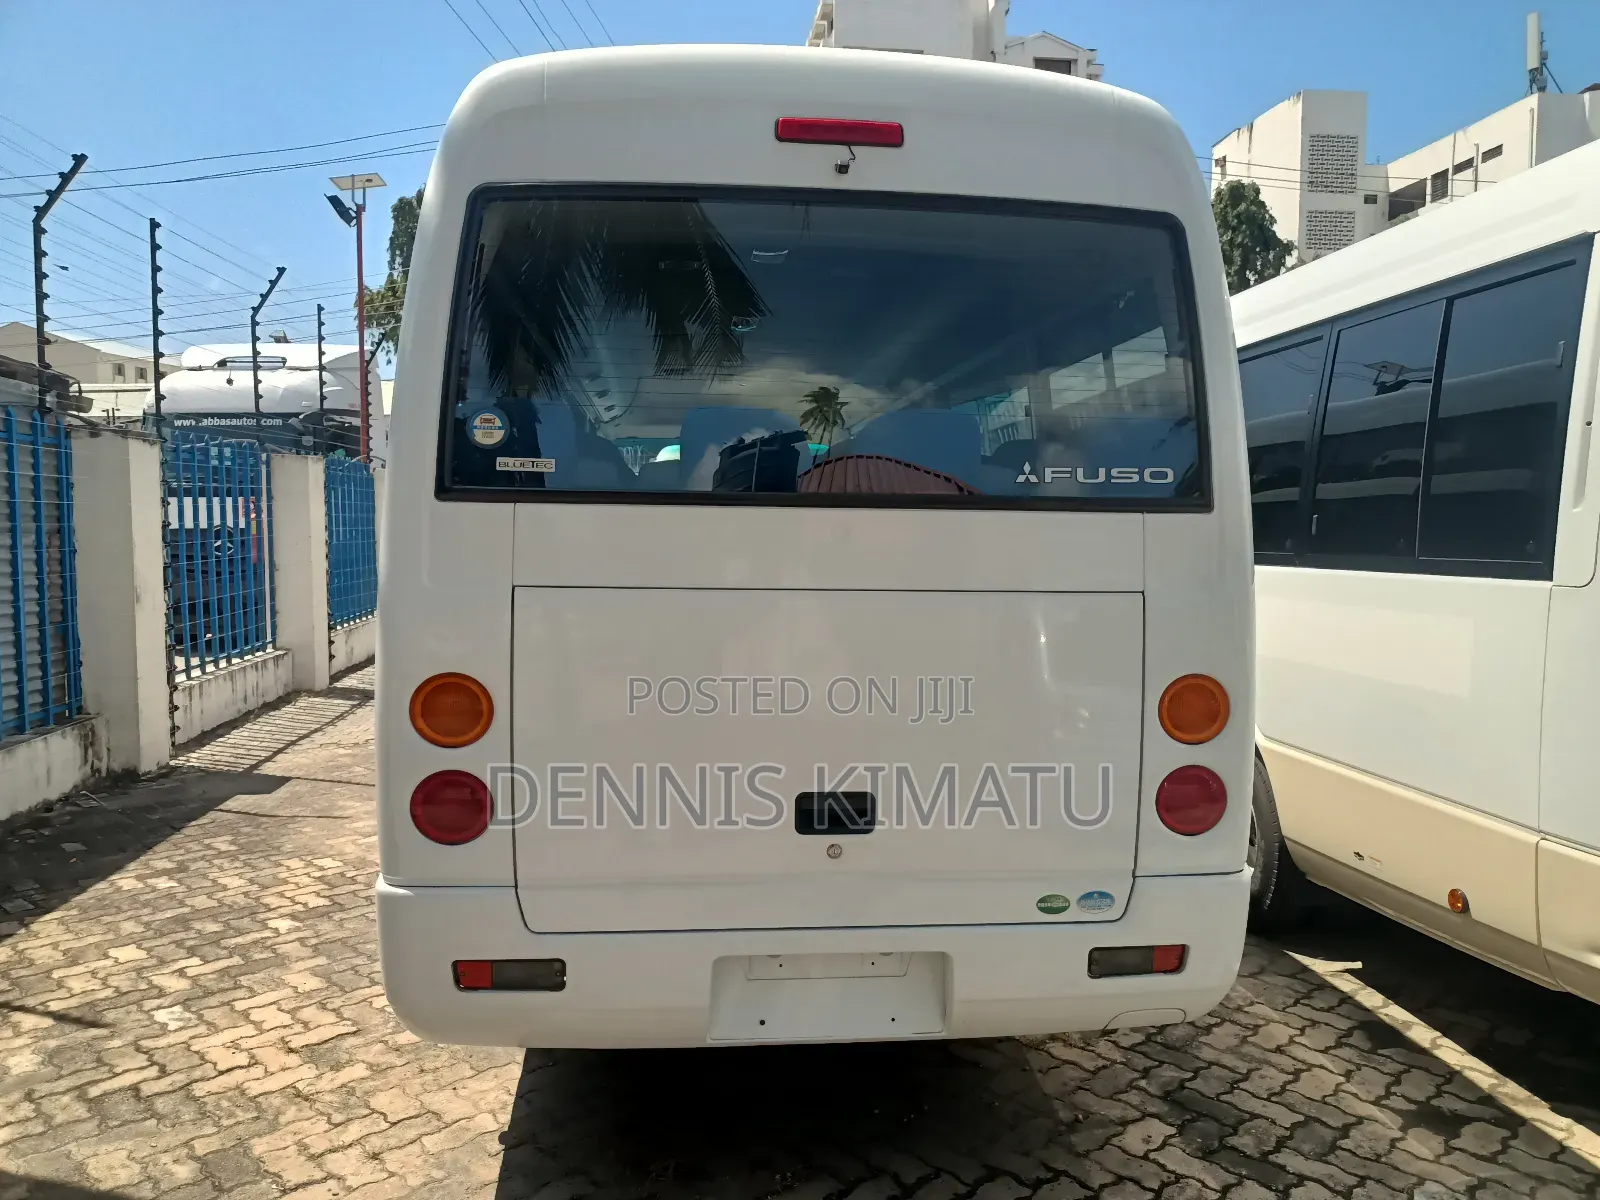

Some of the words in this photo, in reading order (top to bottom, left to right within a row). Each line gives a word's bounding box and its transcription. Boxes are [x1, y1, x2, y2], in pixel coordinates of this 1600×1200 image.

[174, 417, 282, 426] www.abbasautoscom
[498, 460, 553, 469] BLUETEC
[1044, 467, 1174, 484] FUSO
